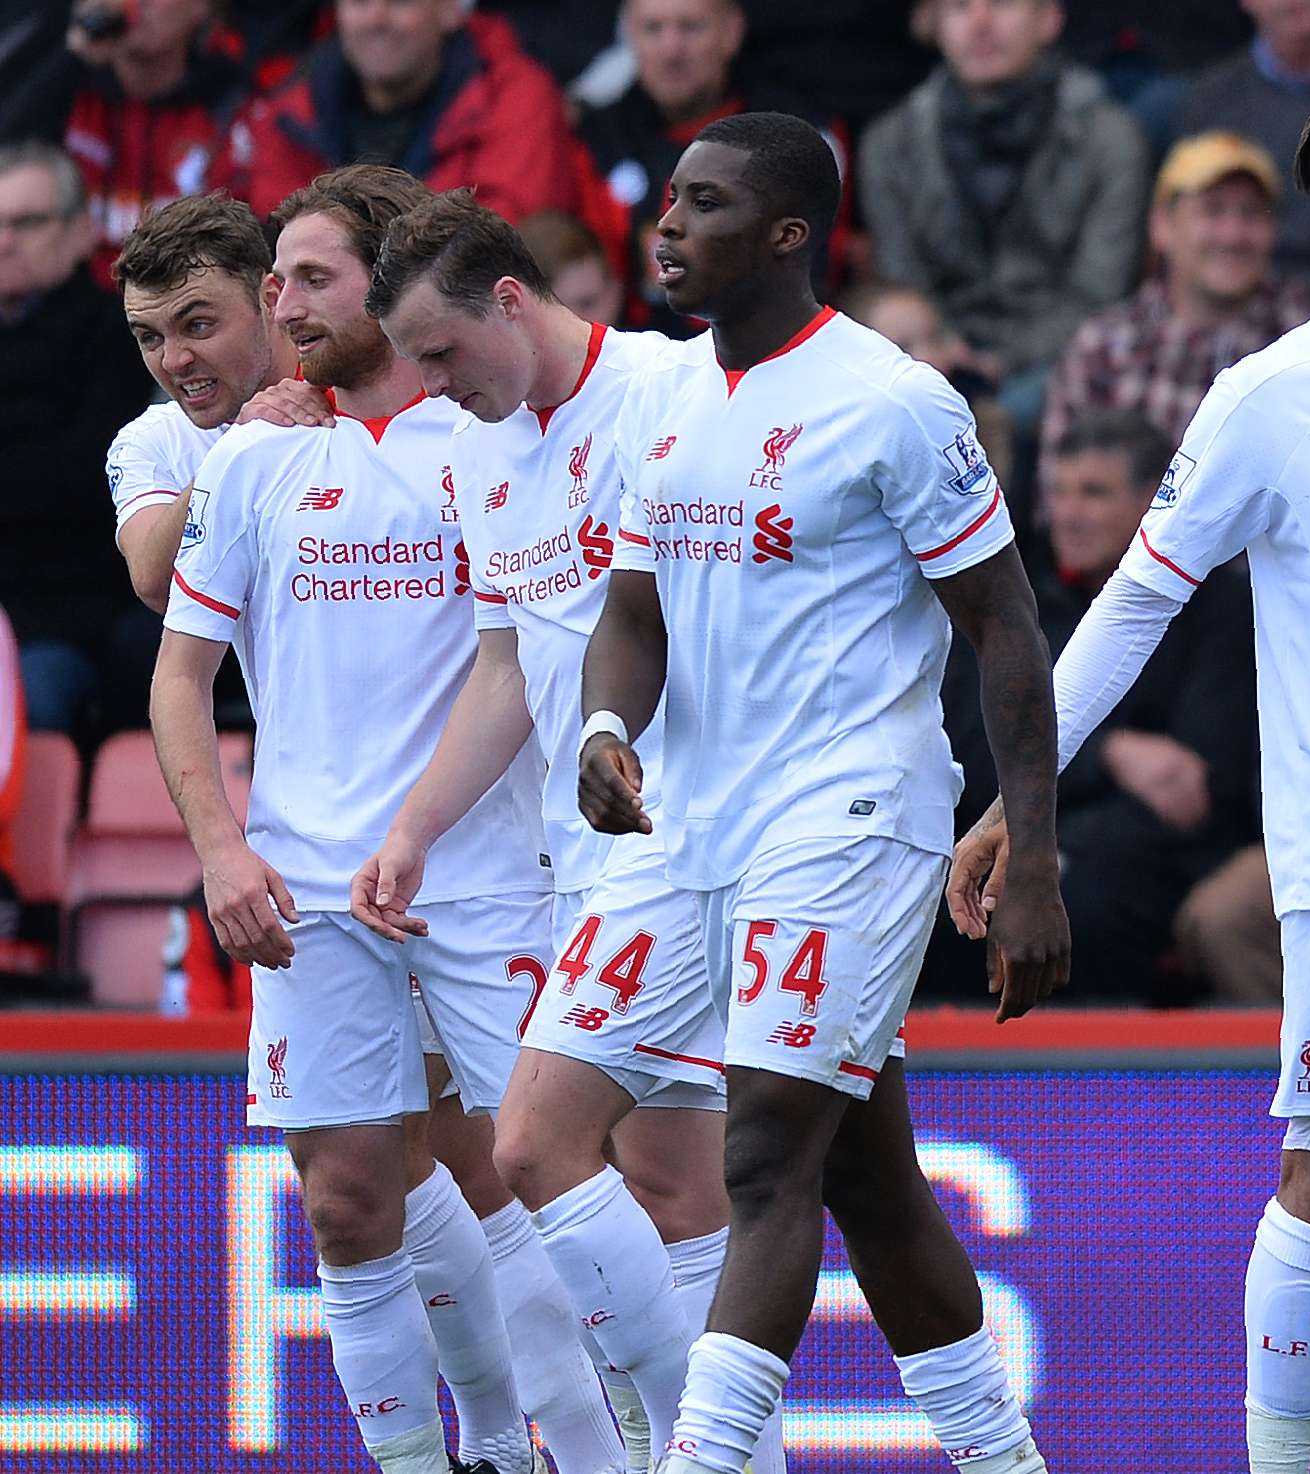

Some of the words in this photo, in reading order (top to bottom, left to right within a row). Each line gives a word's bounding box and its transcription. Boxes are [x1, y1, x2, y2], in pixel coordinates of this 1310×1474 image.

[642, 496, 743, 527] Standard
[298, 534, 444, 564] Standard
[486, 525, 571, 577] Standard
[291, 570, 446, 600] Chartered
[552, 913, 658, 1016] 44
[737, 919, 830, 1018] 54
